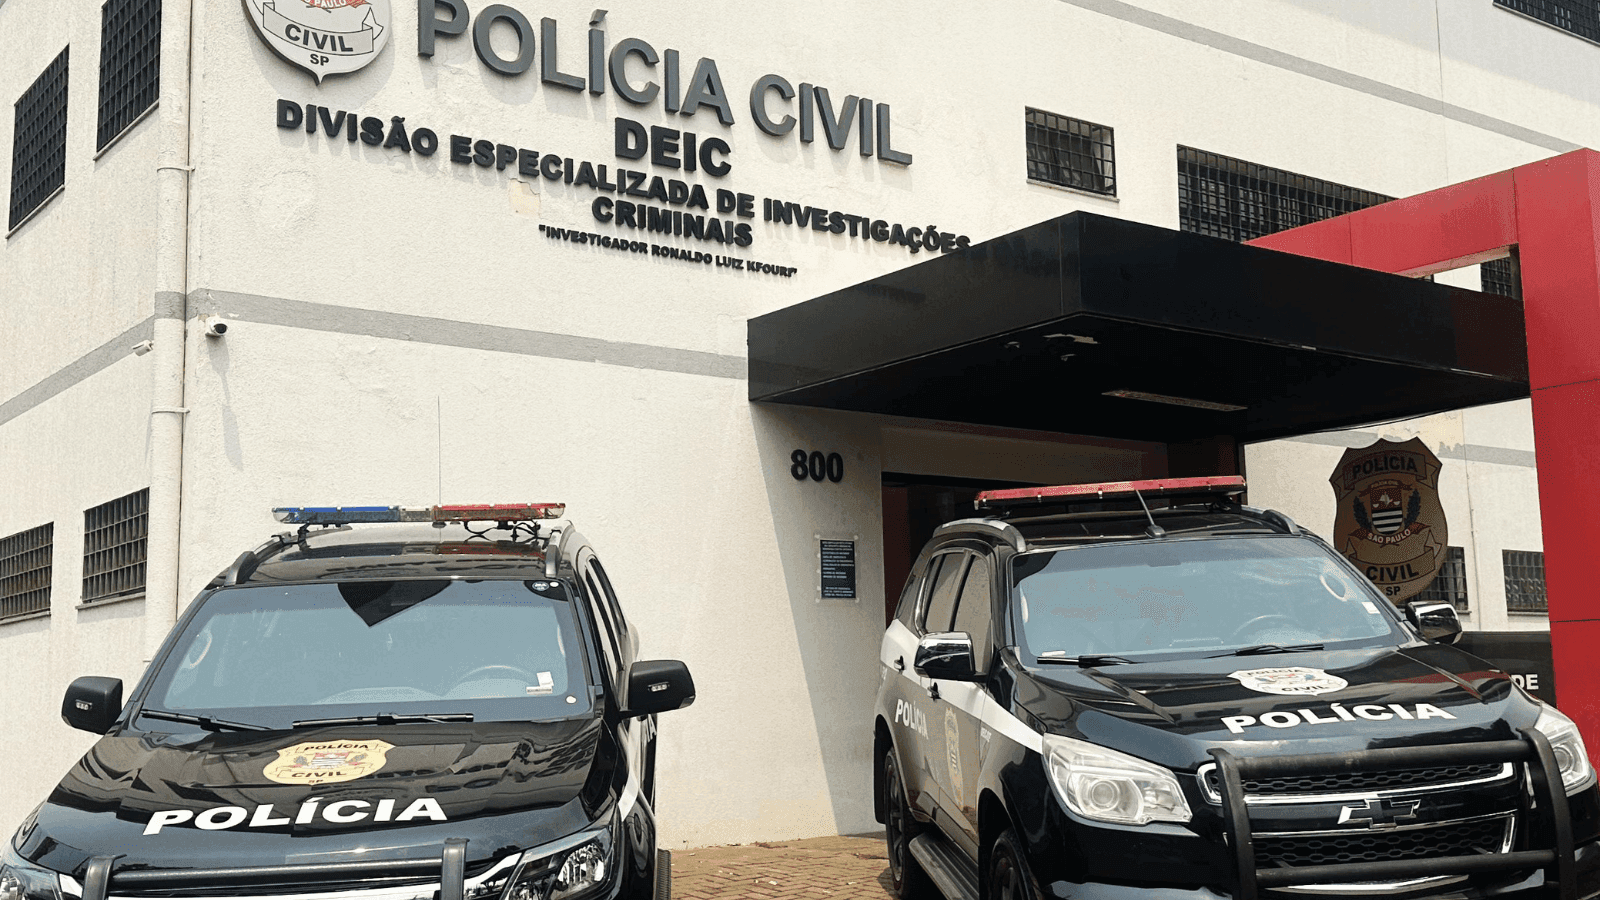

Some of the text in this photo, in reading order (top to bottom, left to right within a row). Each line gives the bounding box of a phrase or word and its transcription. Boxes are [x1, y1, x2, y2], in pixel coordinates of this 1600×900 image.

[285, 24, 353, 52] CIVIL
[310, 53, 330, 66] SP
[418, 0, 912, 166] POLÍCIA CIVIL
[277, 98, 438, 156] DIVISÃO
[450, 134, 709, 210] ESPECIALIZADA
[717, 188, 755, 218] DE
[614, 116, 732, 178] DEIC
[592, 196, 753, 247] CRIMINAIS
[651, 244, 713, 265] RONALDO
[715, 255, 744, 270] LUIZ
[790, 449, 844, 483] 800
[1386, 529, 1411, 544] PAULO
[1366, 564, 1419, 581] CIVIL
[1386, 586, 1400, 596] SP
[1220, 702, 1457, 734] POLÍCIA
[304, 743, 369, 751] POLÍCIA
[142, 797, 448, 836] POLÍCIA
